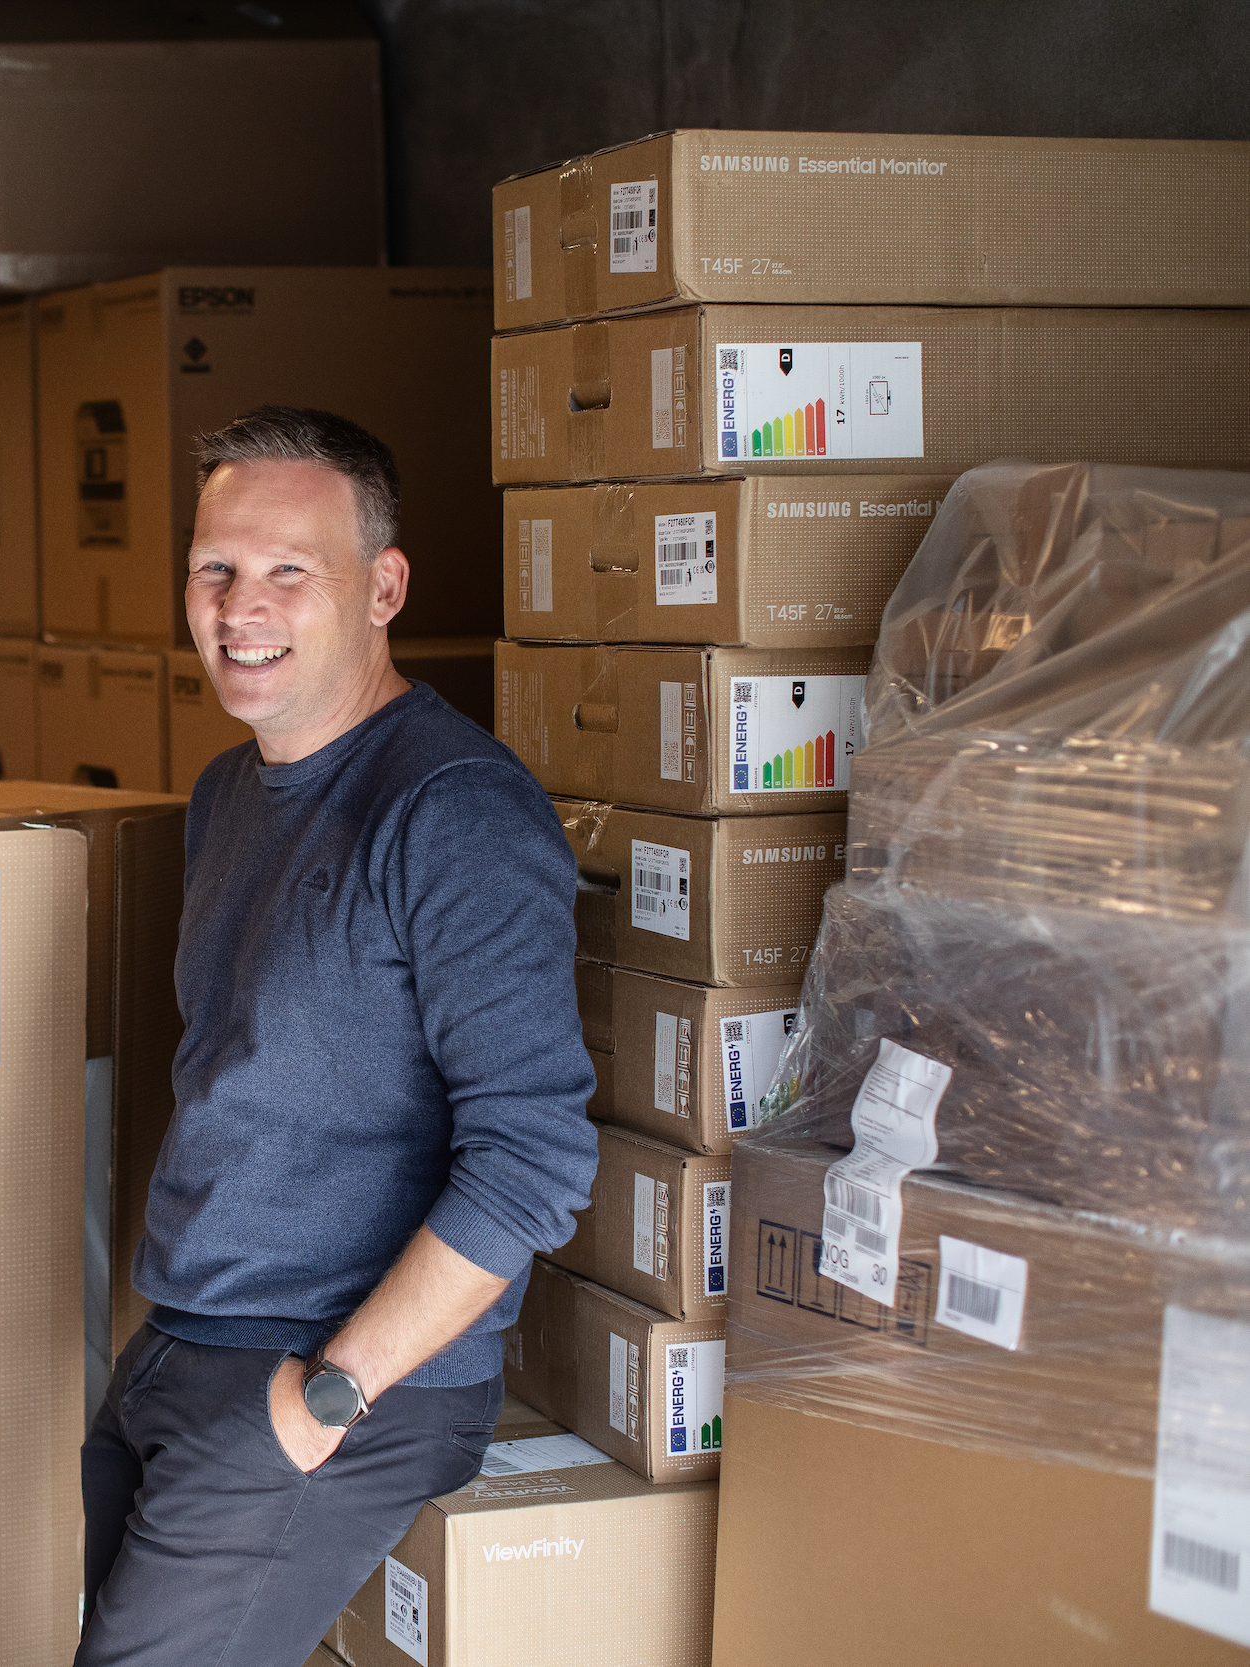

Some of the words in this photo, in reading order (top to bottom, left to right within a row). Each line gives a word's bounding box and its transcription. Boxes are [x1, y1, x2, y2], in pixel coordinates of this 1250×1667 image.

[700, 155, 789, 172] SAMSUNG
[799, 157, 876, 174] Essential
[881, 158, 947, 175] Monitor
[701, 258, 743, 274] T45F
[751, 259, 771, 275] 27
[781, 353, 791, 362] D
[500, 369, 508, 459] SAMSUNG
[836, 409, 846, 425] 17
[767, 502, 851, 518] SAMSUNG
[859, 499, 931, 517] Essential
[767, 605, 807, 621] T45F
[814, 604, 833, 620] 27
[794, 686, 803, 695] D
[846, 741, 854, 756] 17
[742, 846, 826, 865] SAMSUNG
[742, 948, 782, 965] T45F
[790, 946, 808, 962] 27
[872, 1263, 888, 1285] 30
[474, 1485, 575, 1498] ViewFinity
[482, 1535, 585, 1563] ViewFinity
